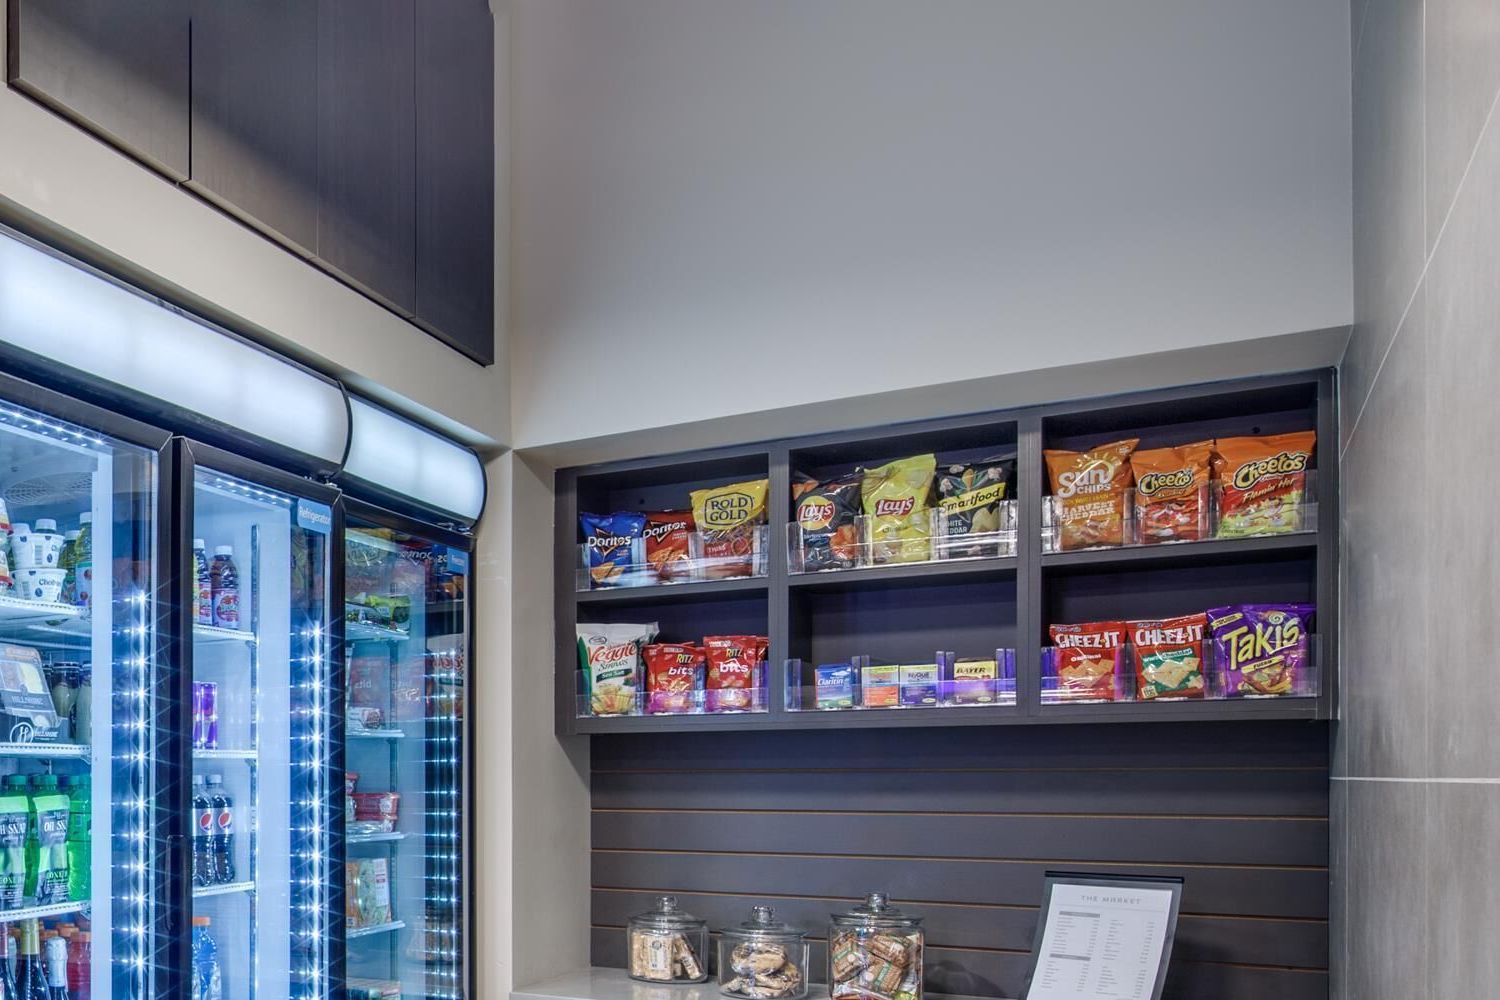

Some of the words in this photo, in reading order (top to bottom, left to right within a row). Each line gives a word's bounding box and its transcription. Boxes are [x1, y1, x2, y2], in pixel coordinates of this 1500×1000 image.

[1234, 452, 1308, 490] Cheetos
[1058, 467, 1112, 498] Sun
[1076, 484, 1111, 494] CHIPS
[711, 496, 748, 511] ROLD
[876, 497, 915, 517] Lay's
[710, 509, 748, 521] GOLD
[643, 521, 687, 539] Doritos
[588, 536, 631, 548] Doritos
[588, 643, 636, 667] Veggie
[676, 653, 694, 664] RITZ
[726, 647, 743, 658] RITZ
[668, 666, 694, 675] bits
[720, 659, 749, 673] bits
[817, 678, 844, 686] Claritin
[1102, 896, 1141, 905] MARKET
